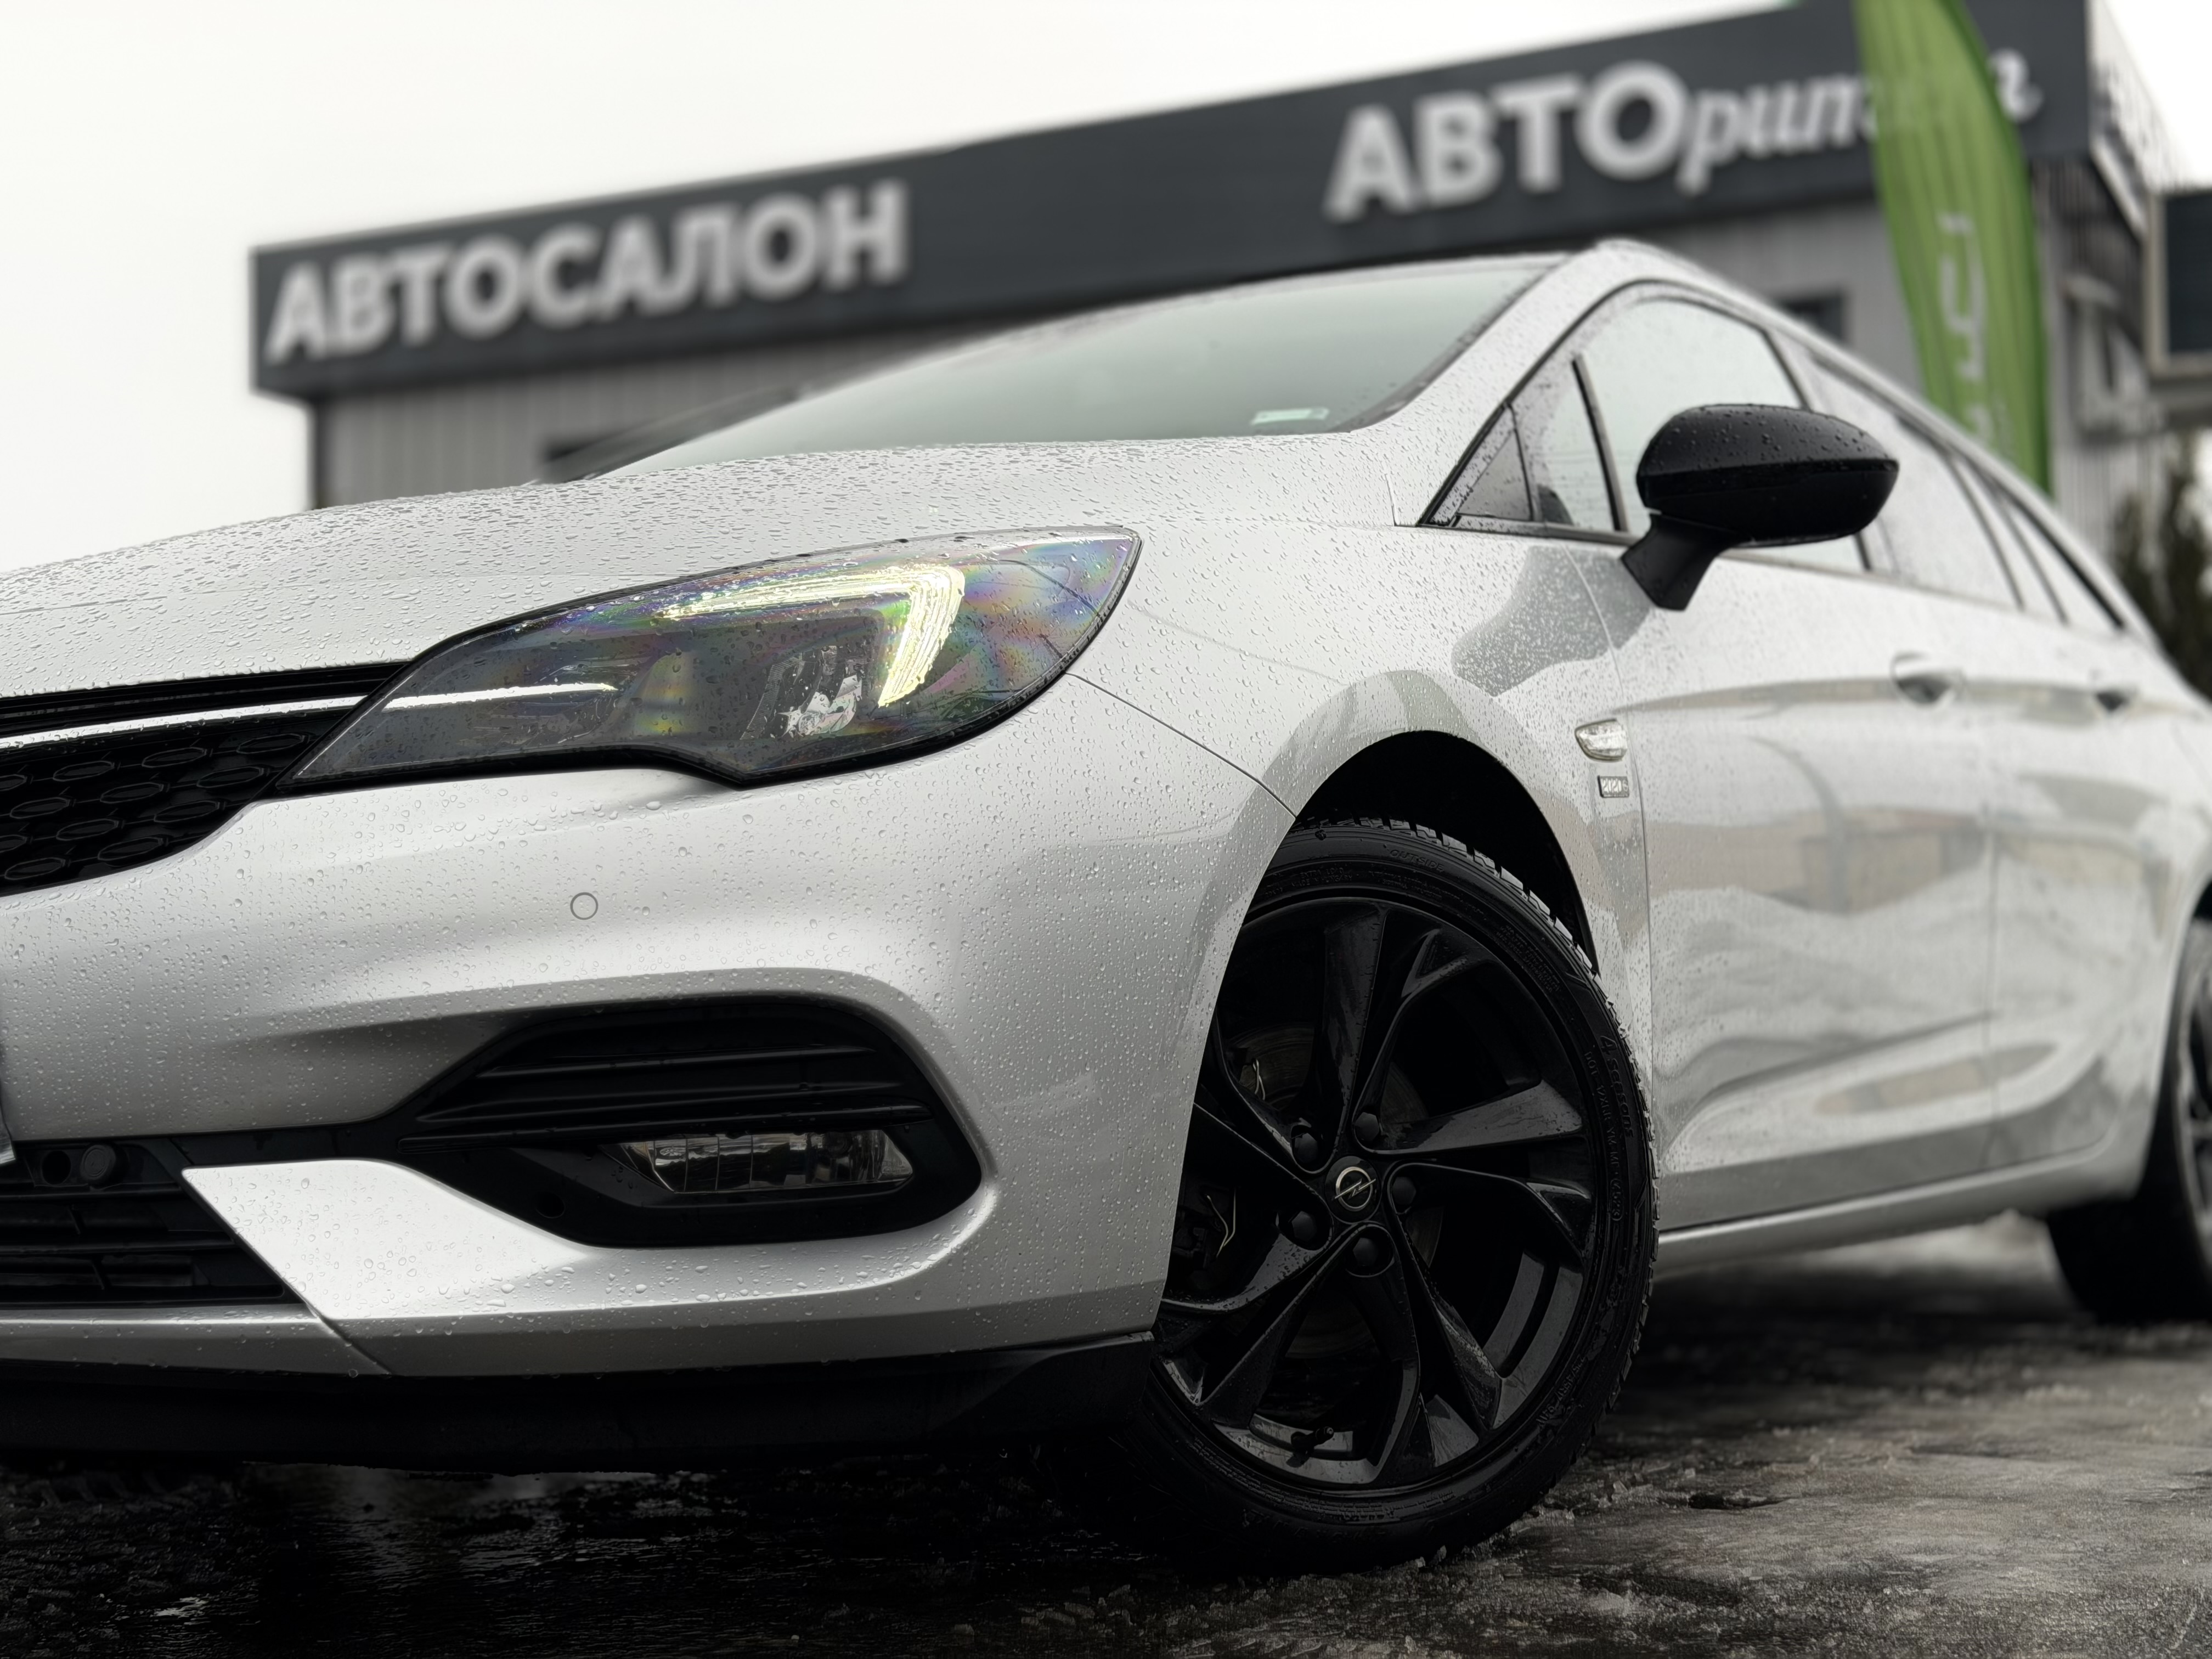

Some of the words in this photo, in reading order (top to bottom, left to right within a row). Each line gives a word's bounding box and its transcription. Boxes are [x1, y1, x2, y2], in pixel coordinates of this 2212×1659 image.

[266, 182, 906, 364] АВТОСАЛОН
[1390, 850, 1445, 872] OUTSIDE
[1600, 1035, 1618, 1056] 4
[1607, 1057, 1634, 1138] seasons
